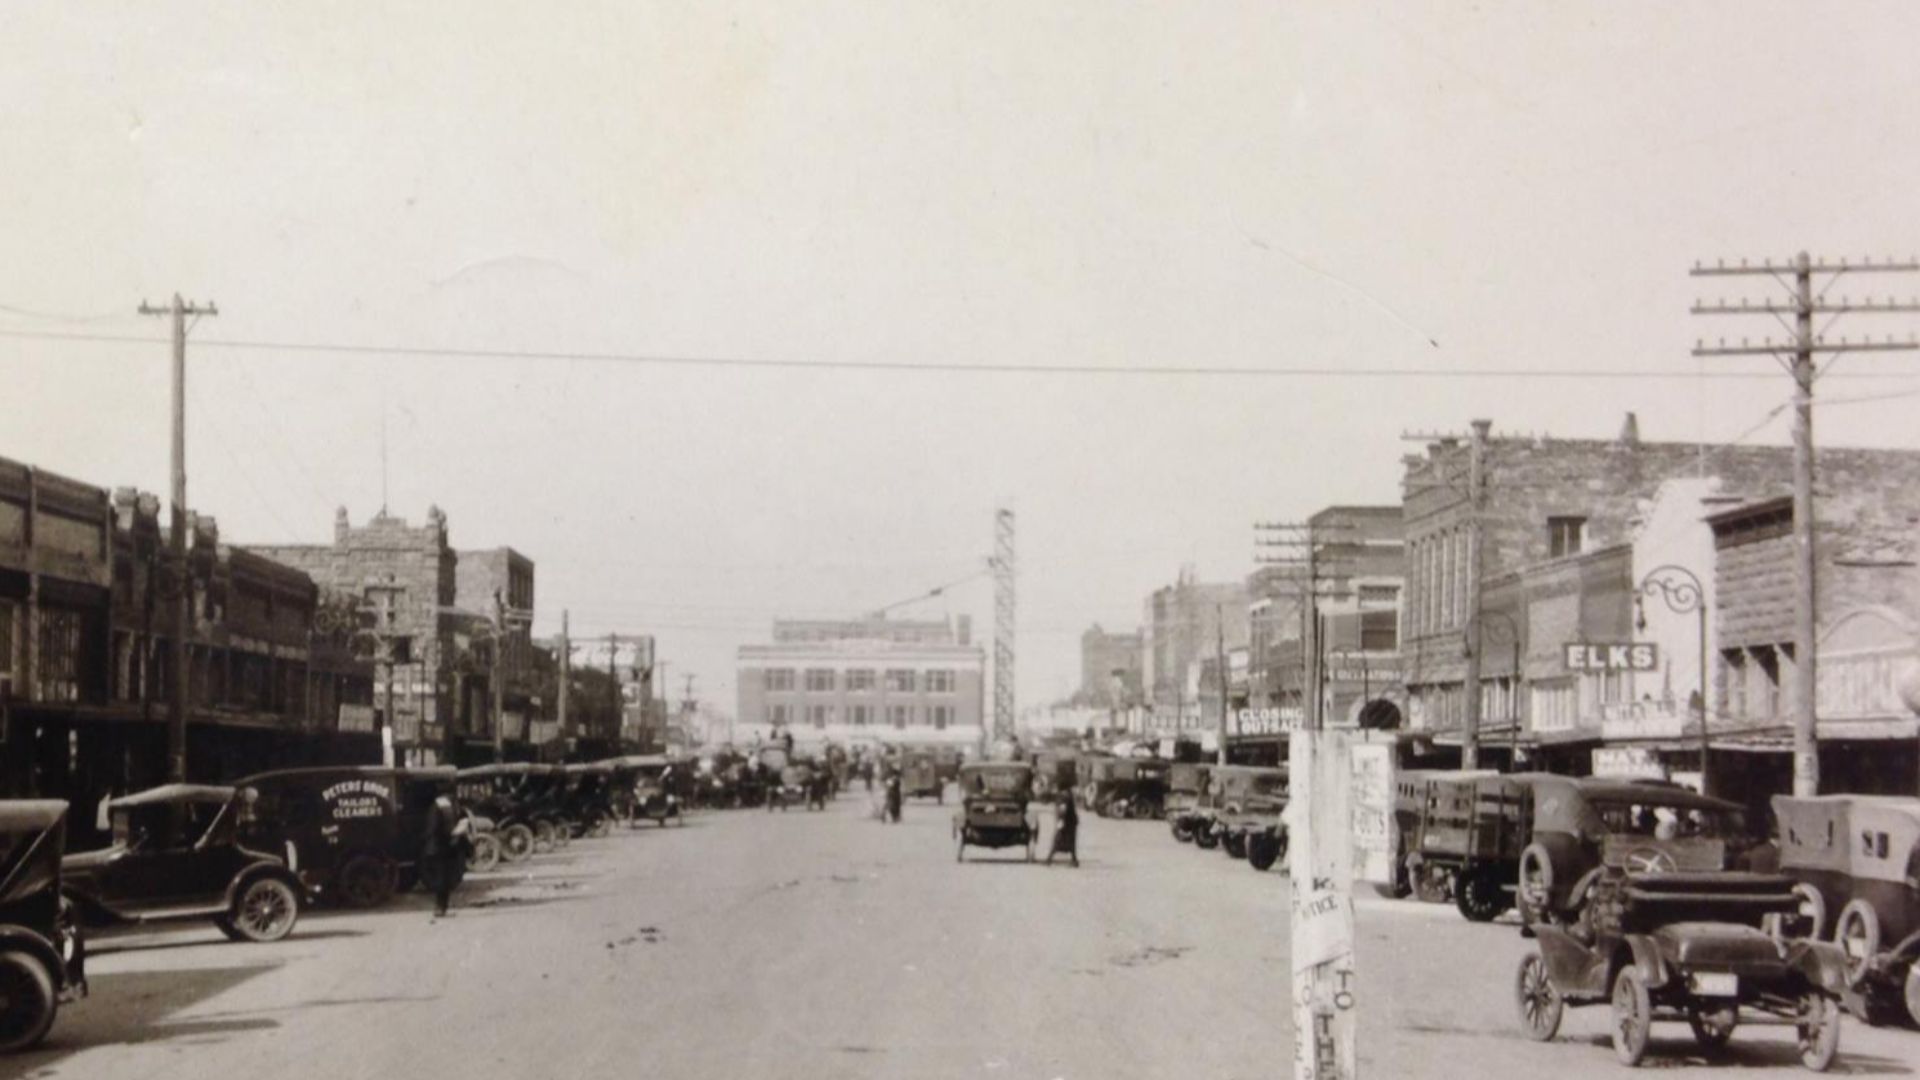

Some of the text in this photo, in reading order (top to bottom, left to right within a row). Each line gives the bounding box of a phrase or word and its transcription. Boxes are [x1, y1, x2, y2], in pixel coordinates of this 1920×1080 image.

[1567, 645, 1653, 668] ELKS
[1239, 707, 1303, 721] CLOSING
[1242, 720, 1268, 735] OUT
[338, 797, 377, 807] TAILORS
[333, 806, 382, 818] CLEANERS
